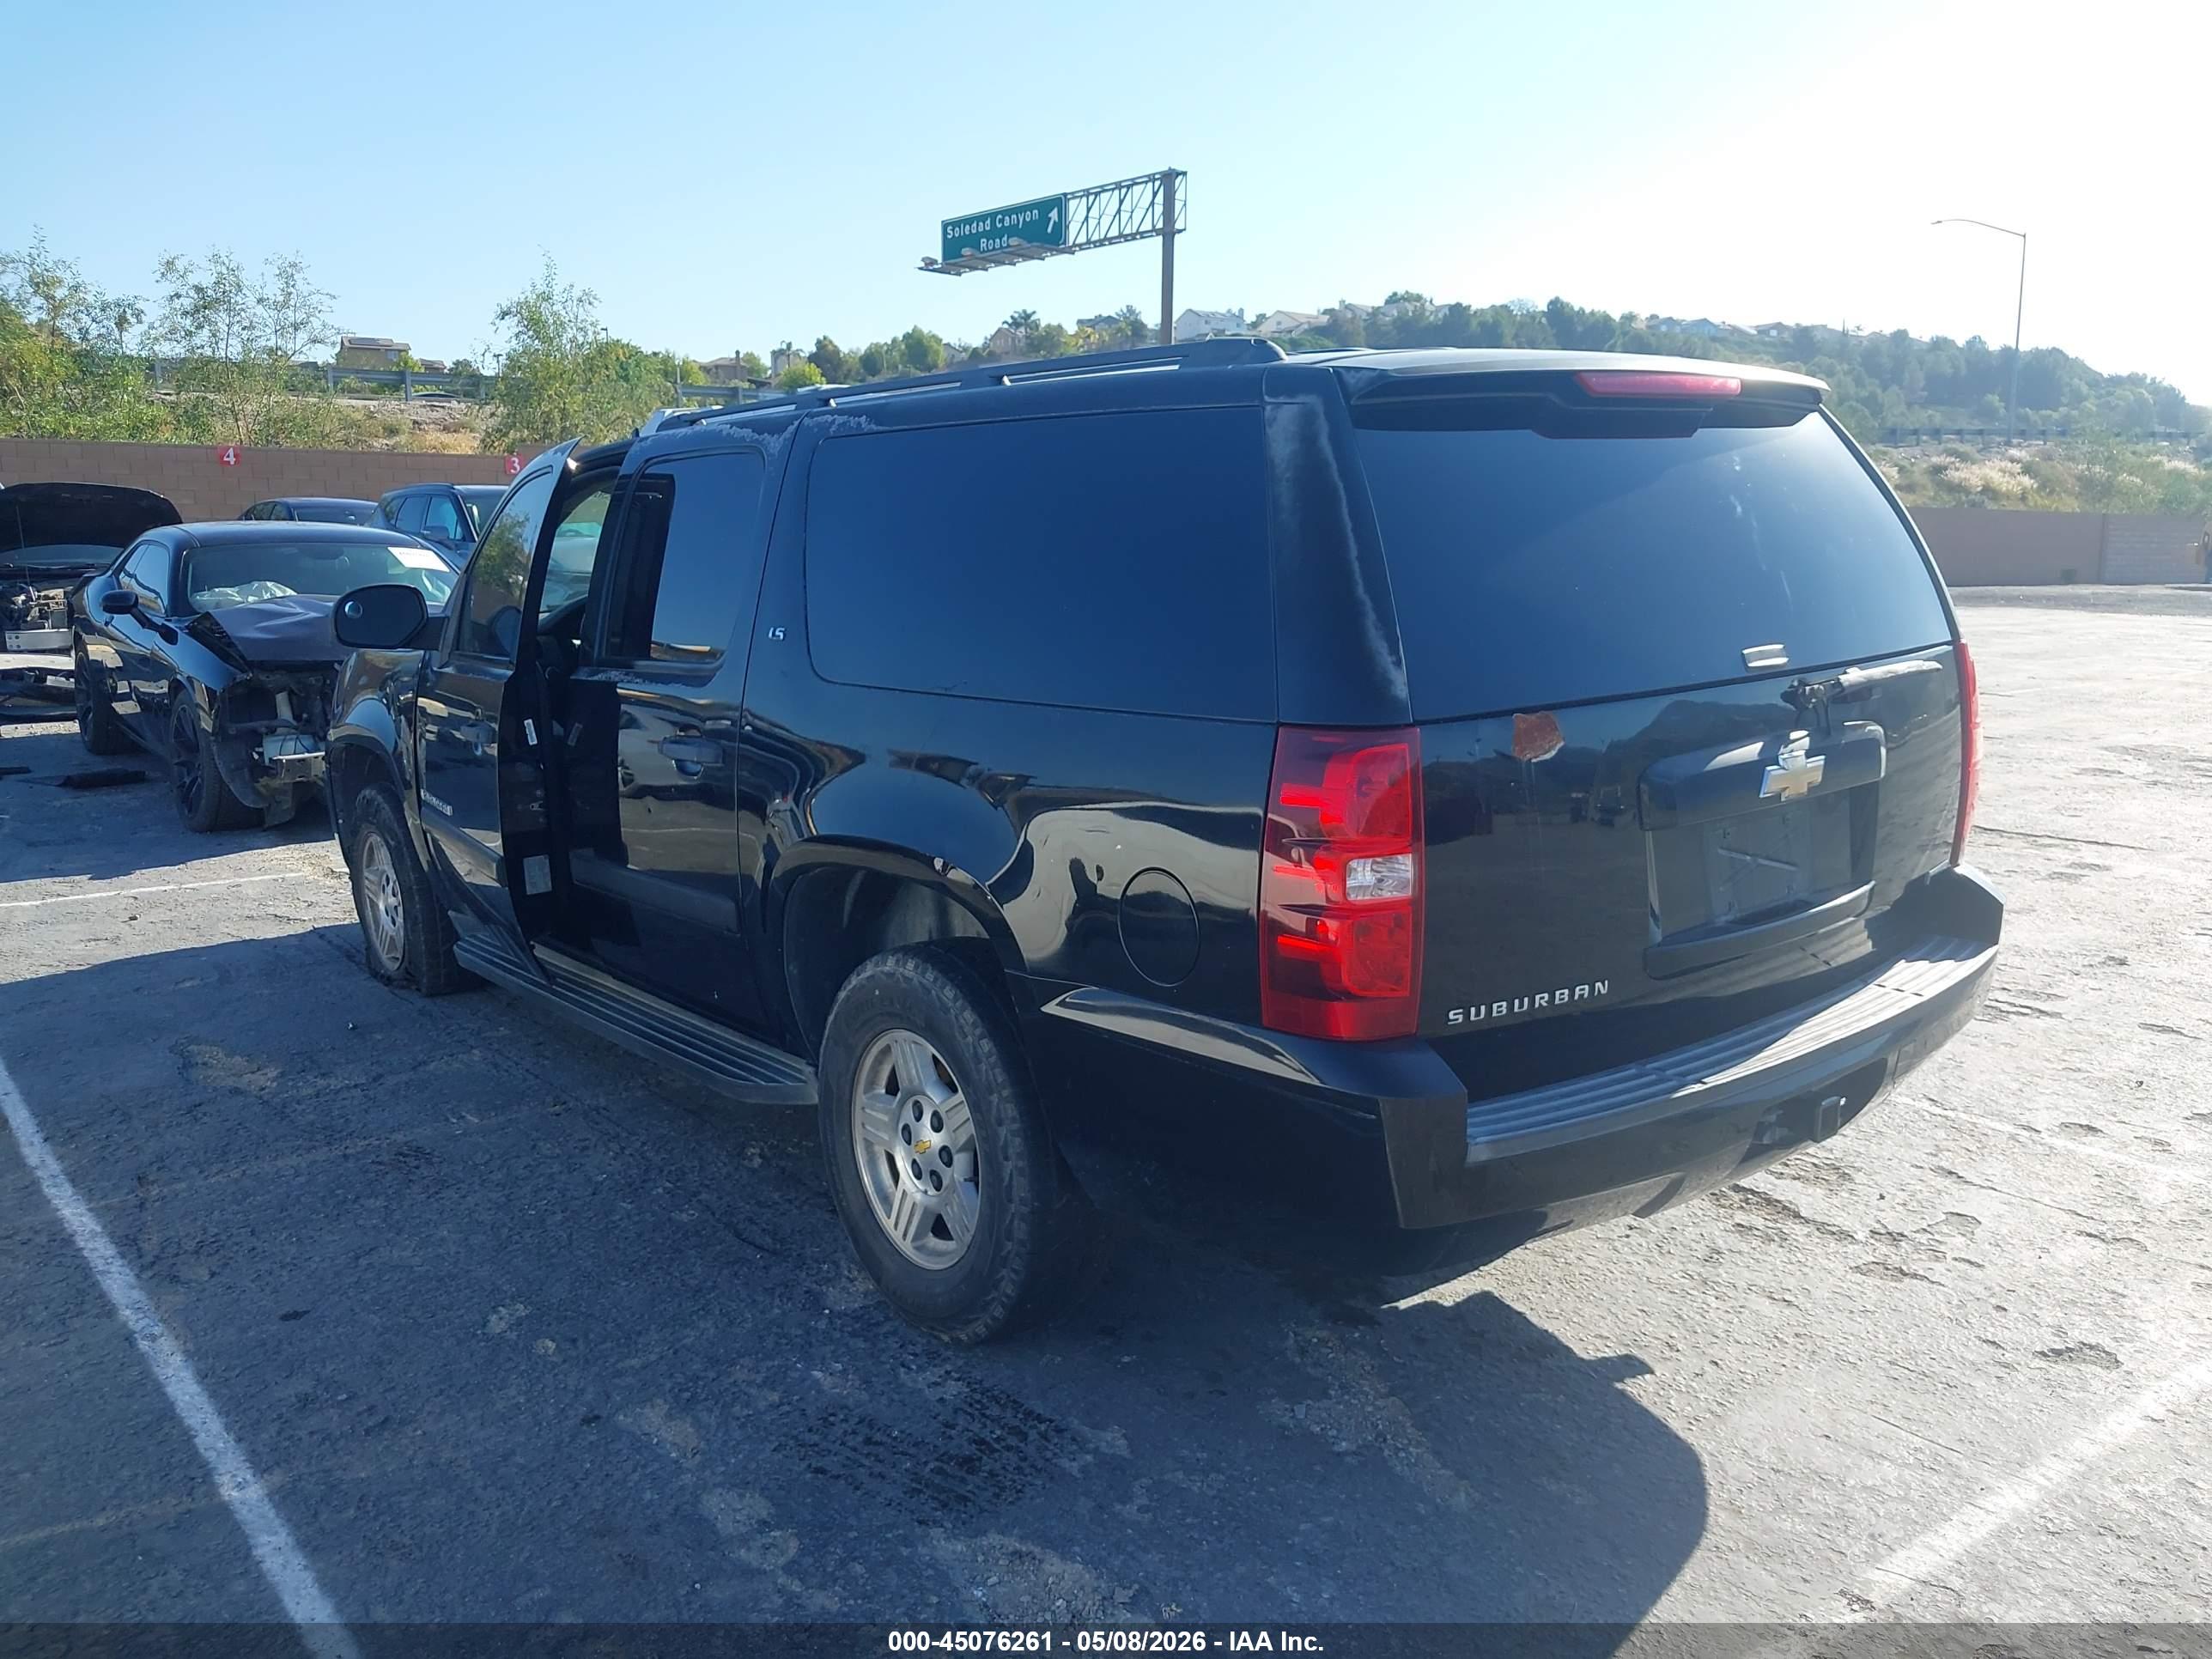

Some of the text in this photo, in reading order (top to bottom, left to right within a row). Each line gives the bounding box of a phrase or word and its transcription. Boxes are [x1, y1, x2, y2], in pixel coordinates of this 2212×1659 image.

[946, 209, 1039, 239] Soledad Canyon
[980, 234, 1007, 252] Road
[223, 447, 236, 465] 4
[510, 457, 520, 473] 3
[1447, 980, 1608, 1025] SUBURBAN
